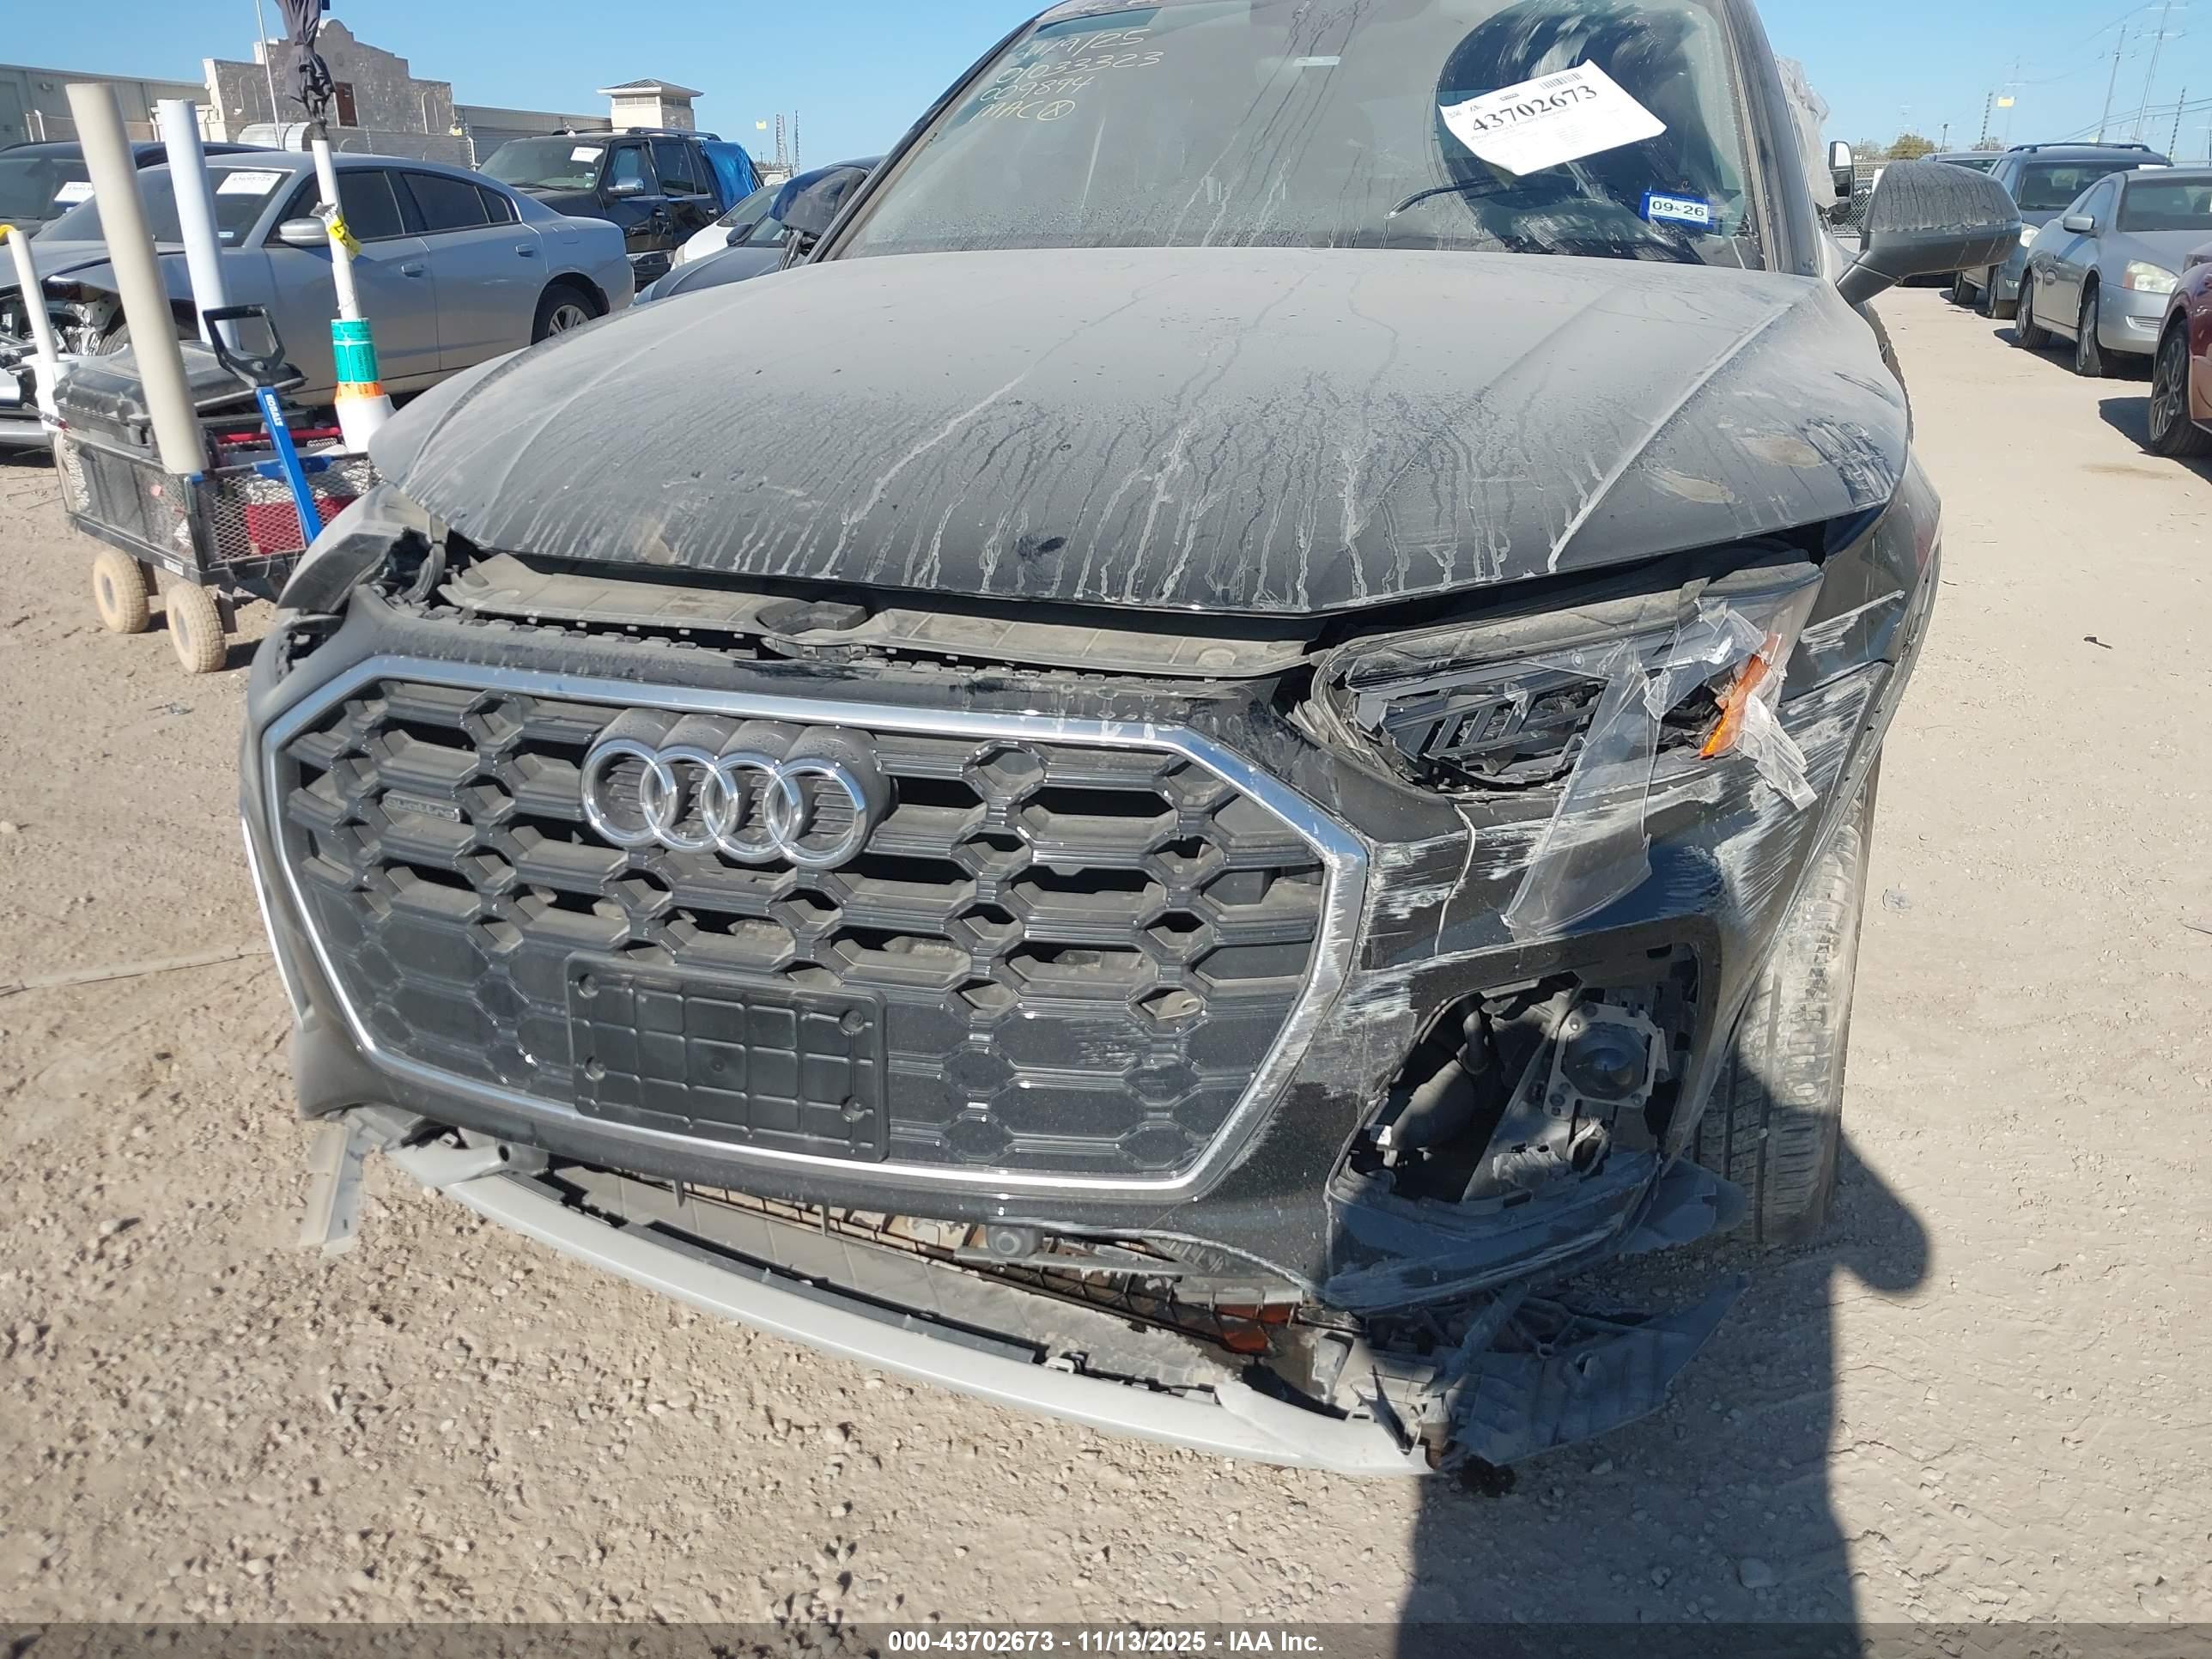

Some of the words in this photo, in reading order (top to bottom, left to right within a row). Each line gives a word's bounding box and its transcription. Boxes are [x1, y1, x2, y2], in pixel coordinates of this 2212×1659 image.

[980, 76, 1095, 101] 009894
[1473, 85, 1597, 131] 43702673
[264, 394, 283, 426] KOBALT
